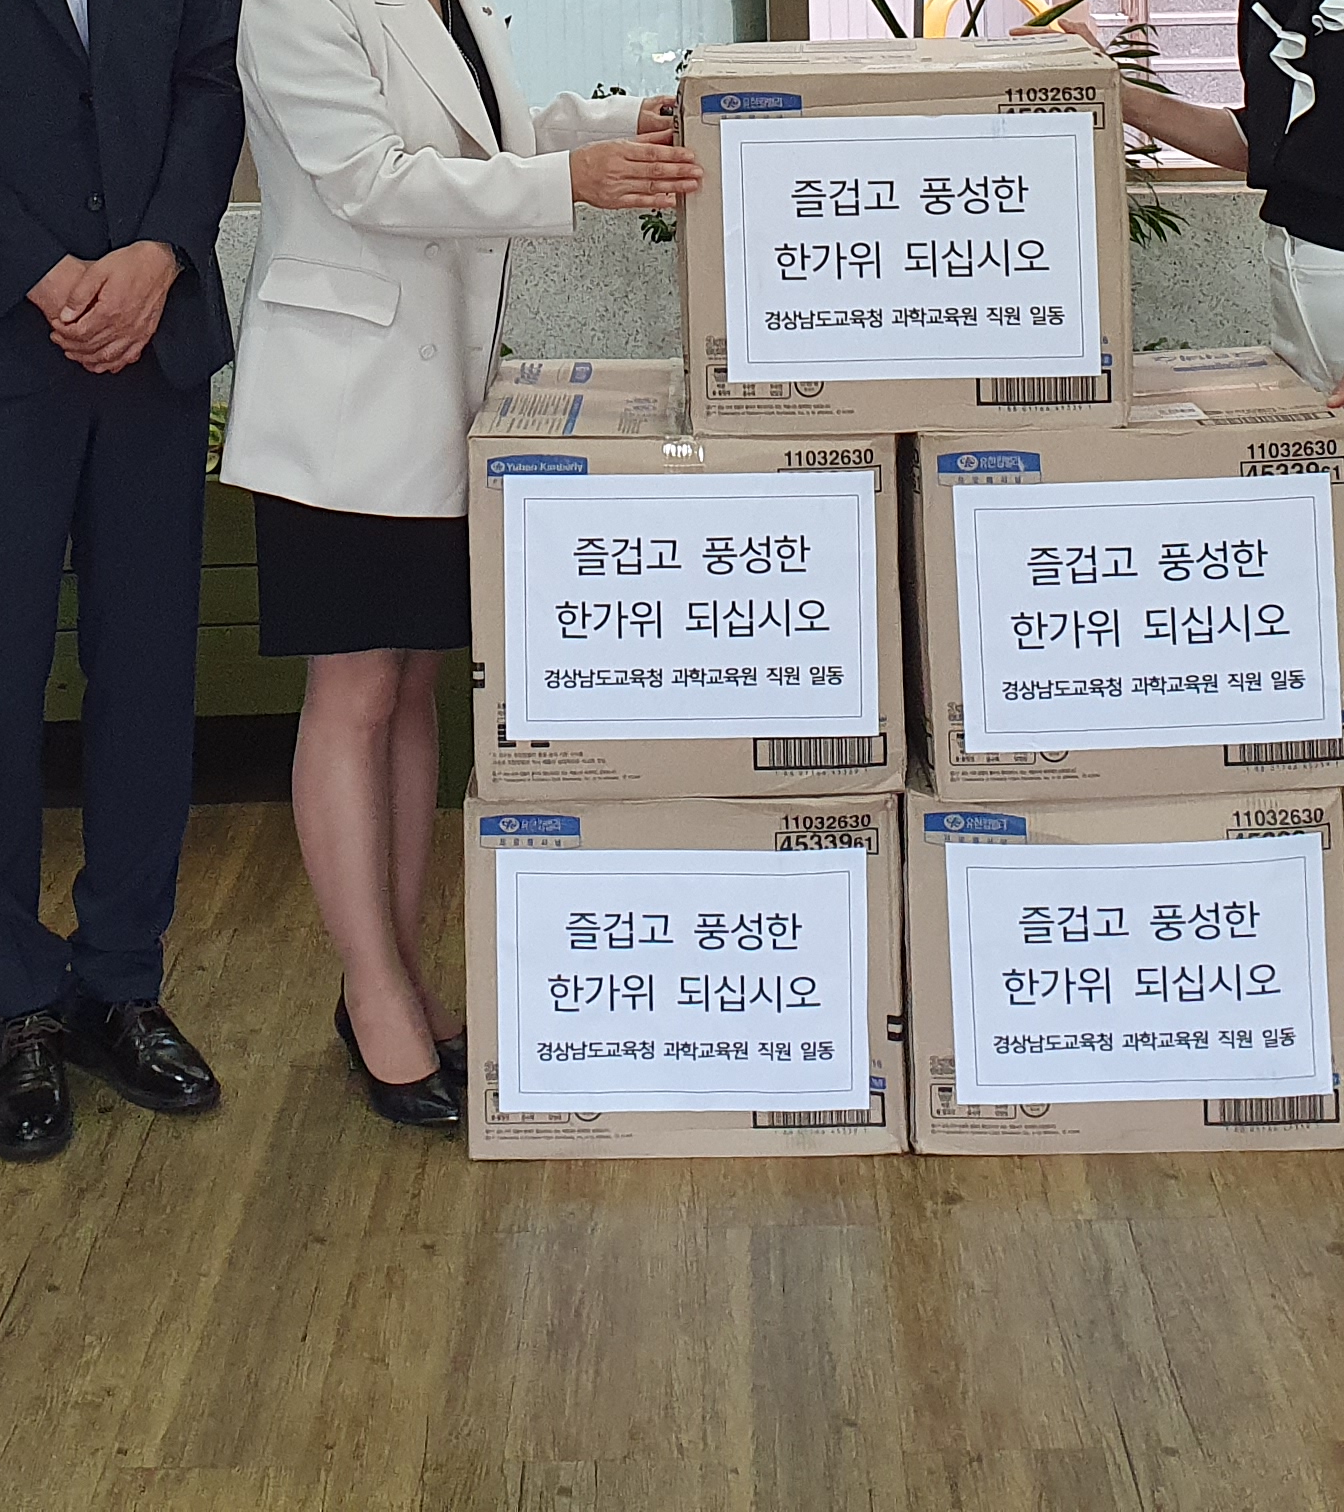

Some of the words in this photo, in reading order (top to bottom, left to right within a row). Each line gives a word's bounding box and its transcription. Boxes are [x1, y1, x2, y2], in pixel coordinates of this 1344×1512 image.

[1005, 86, 1096, 102] 11032630
[791, 178, 900, 218] 즐겁고
[919, 175, 1029, 216] 풍성한
[774, 240, 881, 281] 한가위
[904, 238, 1050, 278] 되십시오
[764, 308, 883, 331] 경상남도교육청
[891, 306, 978, 328] 과학교육원
[986, 306, 1021, 326] 직원
[1029, 305, 1066, 326] 일동
[784, 449, 874, 466] 11032630
[1247, 439, 1336, 459] 11032630
[573, 537, 682, 576] 즐겁고
[702, 534, 811, 576] 풍성한
[1026, 545, 1139, 586] 즐겁고
[1158, 538, 1269, 582] 풍성한
[555, 600, 662, 640] 한가위
[685, 598, 830, 638] 되십시오
[1010, 608, 1120, 650] 한가위
[1143, 603, 1291, 646] 되십시오
[544, 668, 663, 689] 경상남도교육청
[671, 666, 758, 688] 과학교육원
[766, 666, 801, 687] 직원
[809, 665, 845, 686] 일동
[1002, 676, 1123, 701] 경상남도교육청
[1131, 673, 1219, 696] 과학교육원
[1227, 671, 1262, 692] 직원
[1270, 669, 1306, 691] 일동
[782, 814, 871, 829] 11032630
[1233, 808, 1324, 827] 11032630
[565, 911, 674, 950] 즐겁고
[693, 912, 803, 951] 풍성한
[1018, 905, 1130, 944] 즐겁고
[1149, 900, 1261, 942] 풍성한
[547, 973, 654, 1013] 한가위
[677, 974, 822, 1014] 되십시오
[1002, 967, 1111, 1006] 한가위
[1134, 963, 1281, 1003] 되십시오
[536, 1040, 655, 1062] 경상남도교육청
[663, 1041, 749, 1061] 과학교육원
[757, 1041, 792, 1062] 직원
[800, 1040, 835, 1061] 일동
[993, 1032, 1113, 1055] 경상남도교육청
[1121, 1030, 1209, 1052] 과학교육원
[1218, 1029, 1253, 1050] 직원
[1262, 1026, 1296, 1049] 일동
